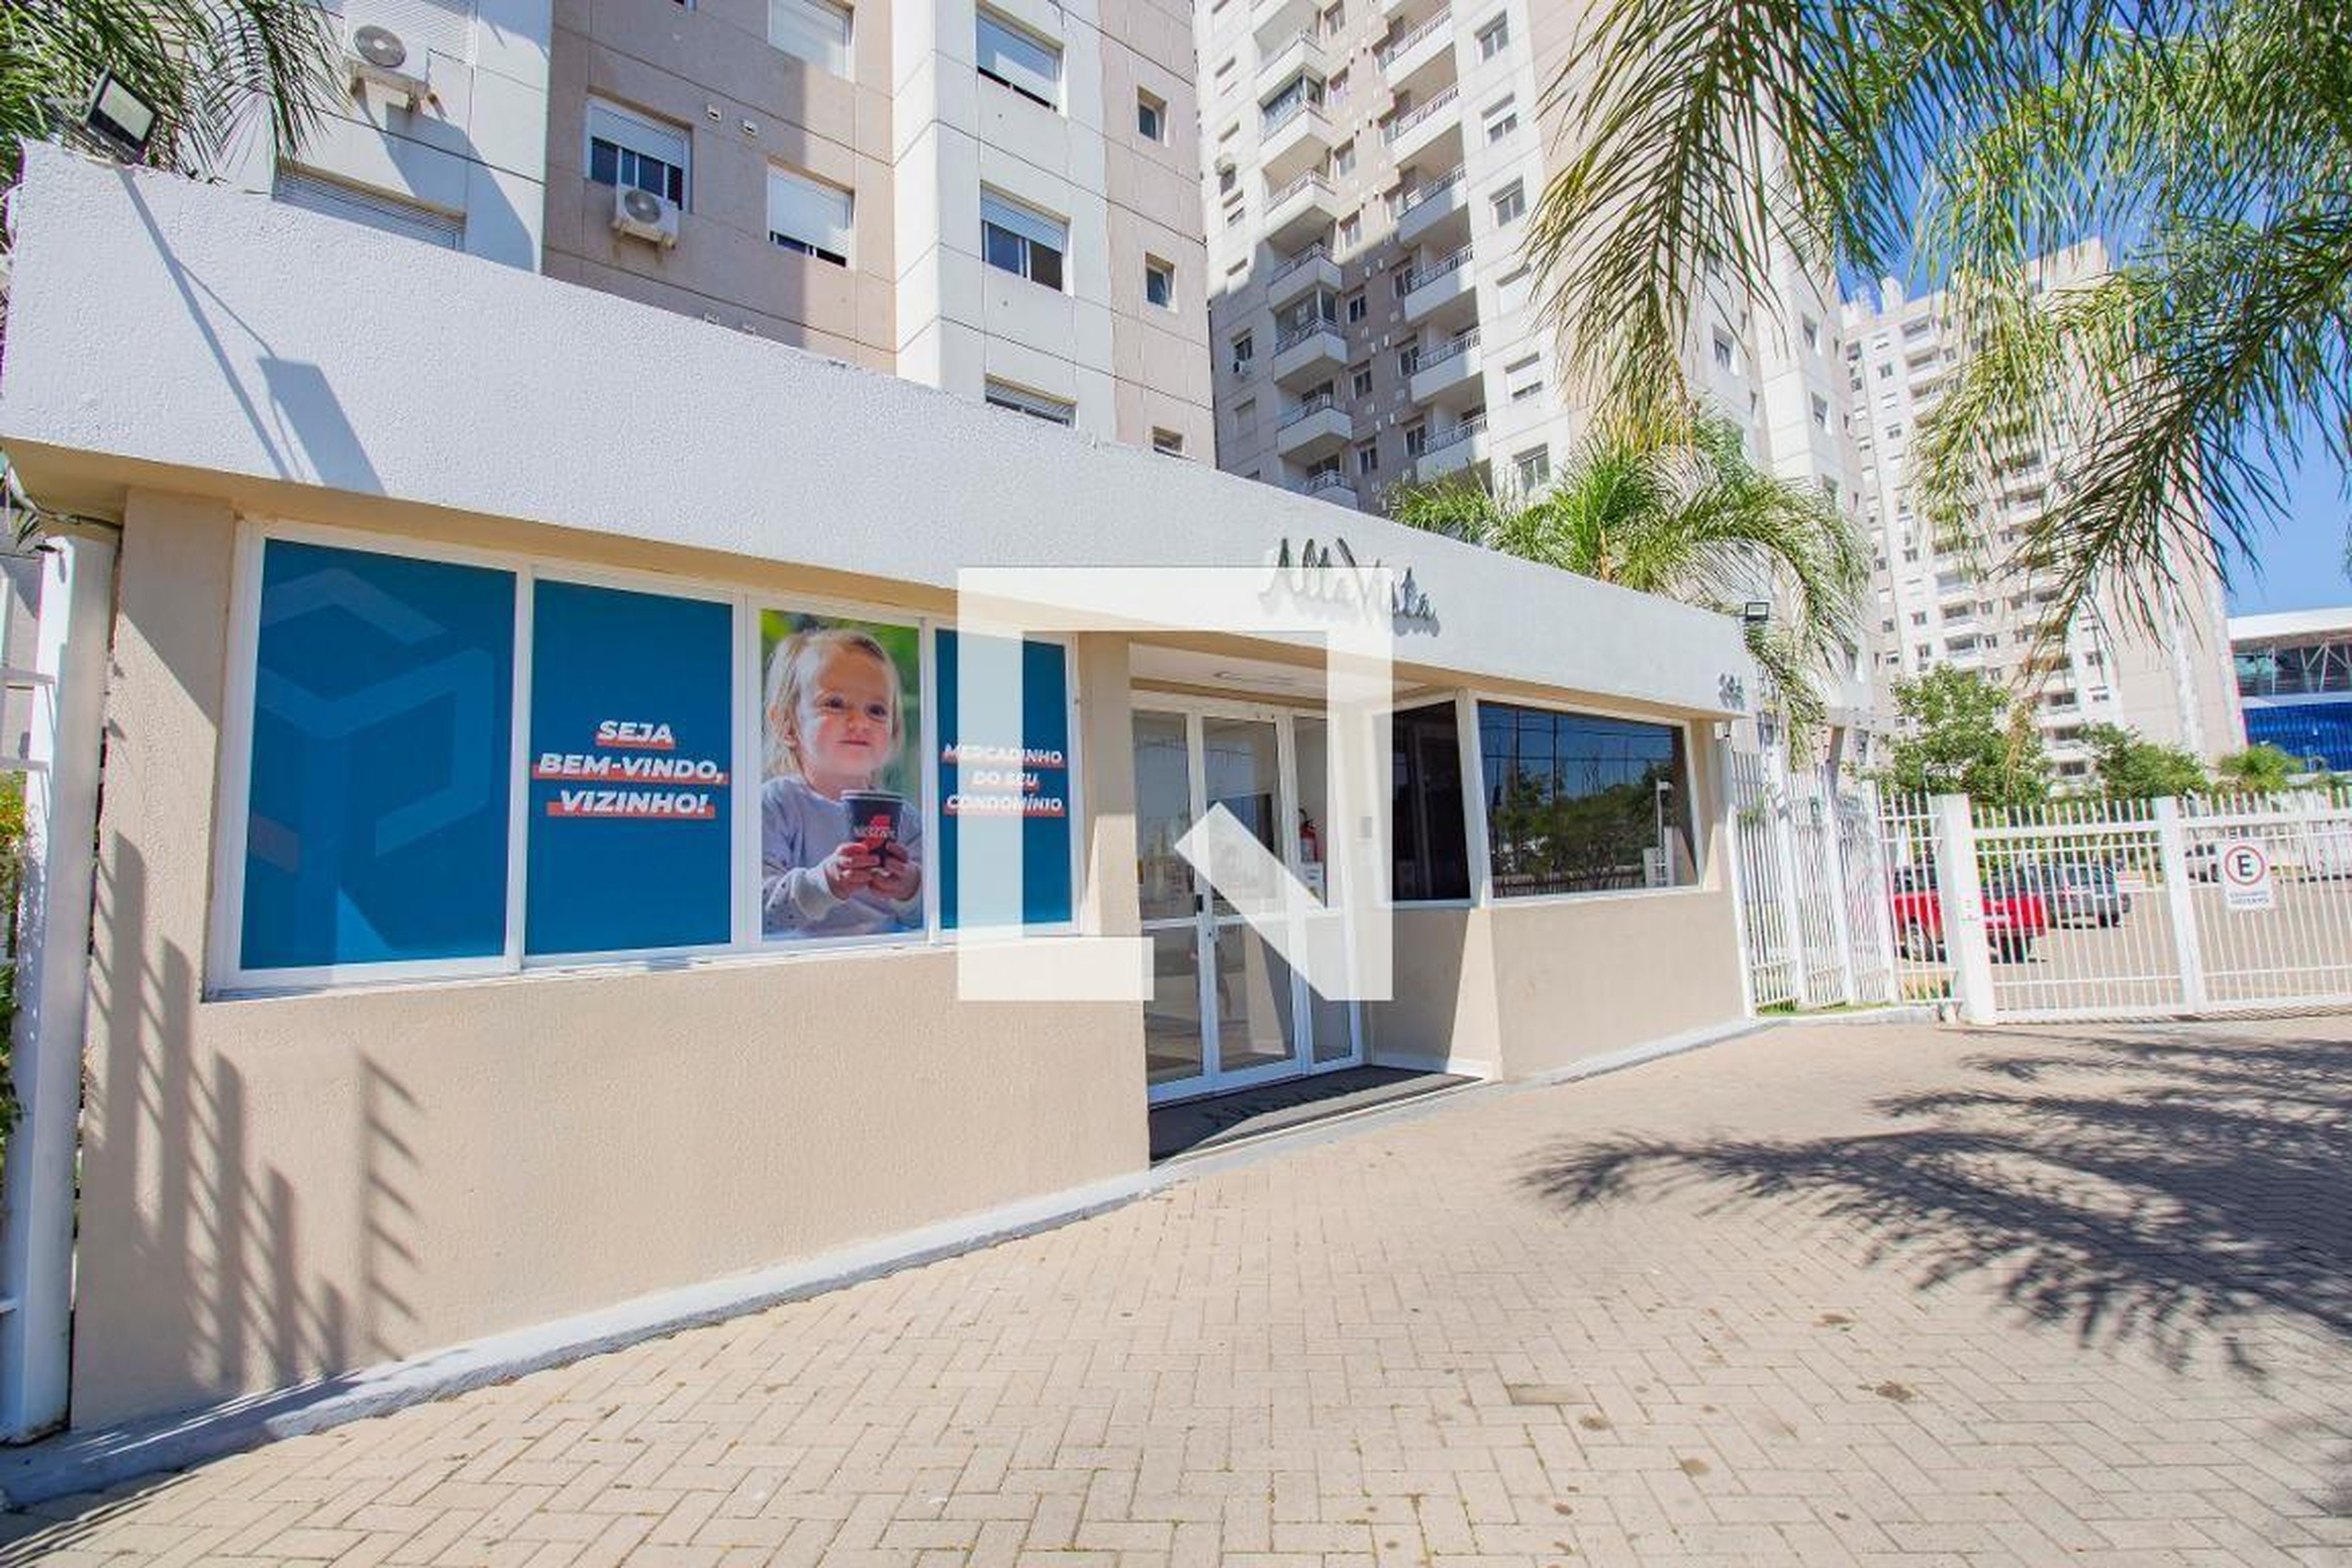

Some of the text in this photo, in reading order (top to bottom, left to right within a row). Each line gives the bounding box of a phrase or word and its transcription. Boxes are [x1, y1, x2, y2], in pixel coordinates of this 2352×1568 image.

[598, 720, 674, 743] SEJA
[538, 753, 724, 783] BEM-VINDO,
[559, 790, 709, 814] VIZINHO!
[2237, 854, 2253, 876] E
